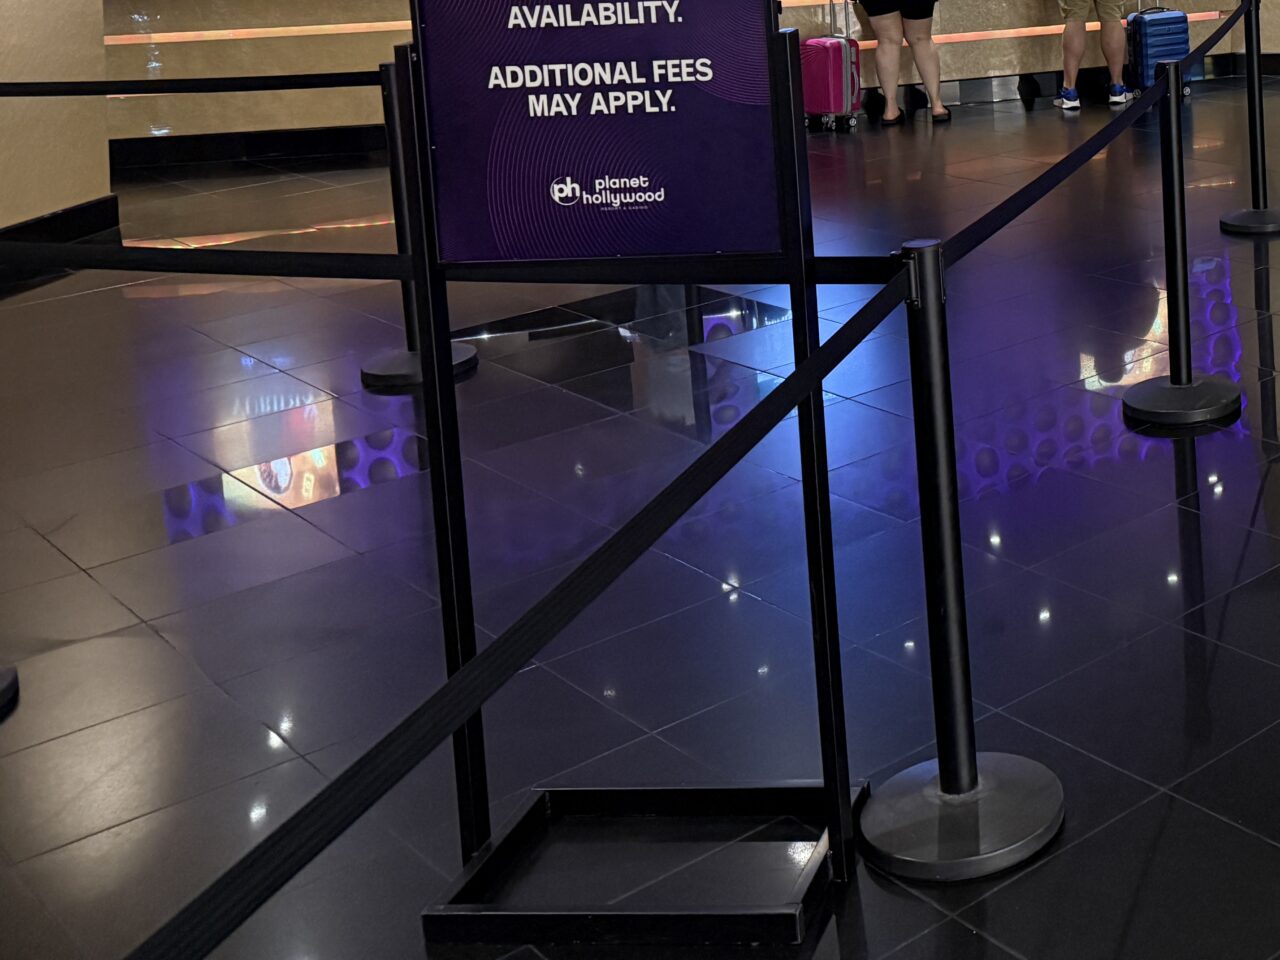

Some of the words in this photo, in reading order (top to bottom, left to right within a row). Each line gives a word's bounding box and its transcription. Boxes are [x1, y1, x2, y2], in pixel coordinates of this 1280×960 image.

[508, 0, 683, 29] AVAILABILITY.
[488, 61, 646, 89] ADDITIONAL
[653, 58, 713, 83] FEES
[528, 92, 582, 117] MAY
[590, 89, 676, 115] APPLY.
[552, 177, 580, 202] ph
[582, 187, 665, 207] hollywood
[595, 175, 649, 193] planet
